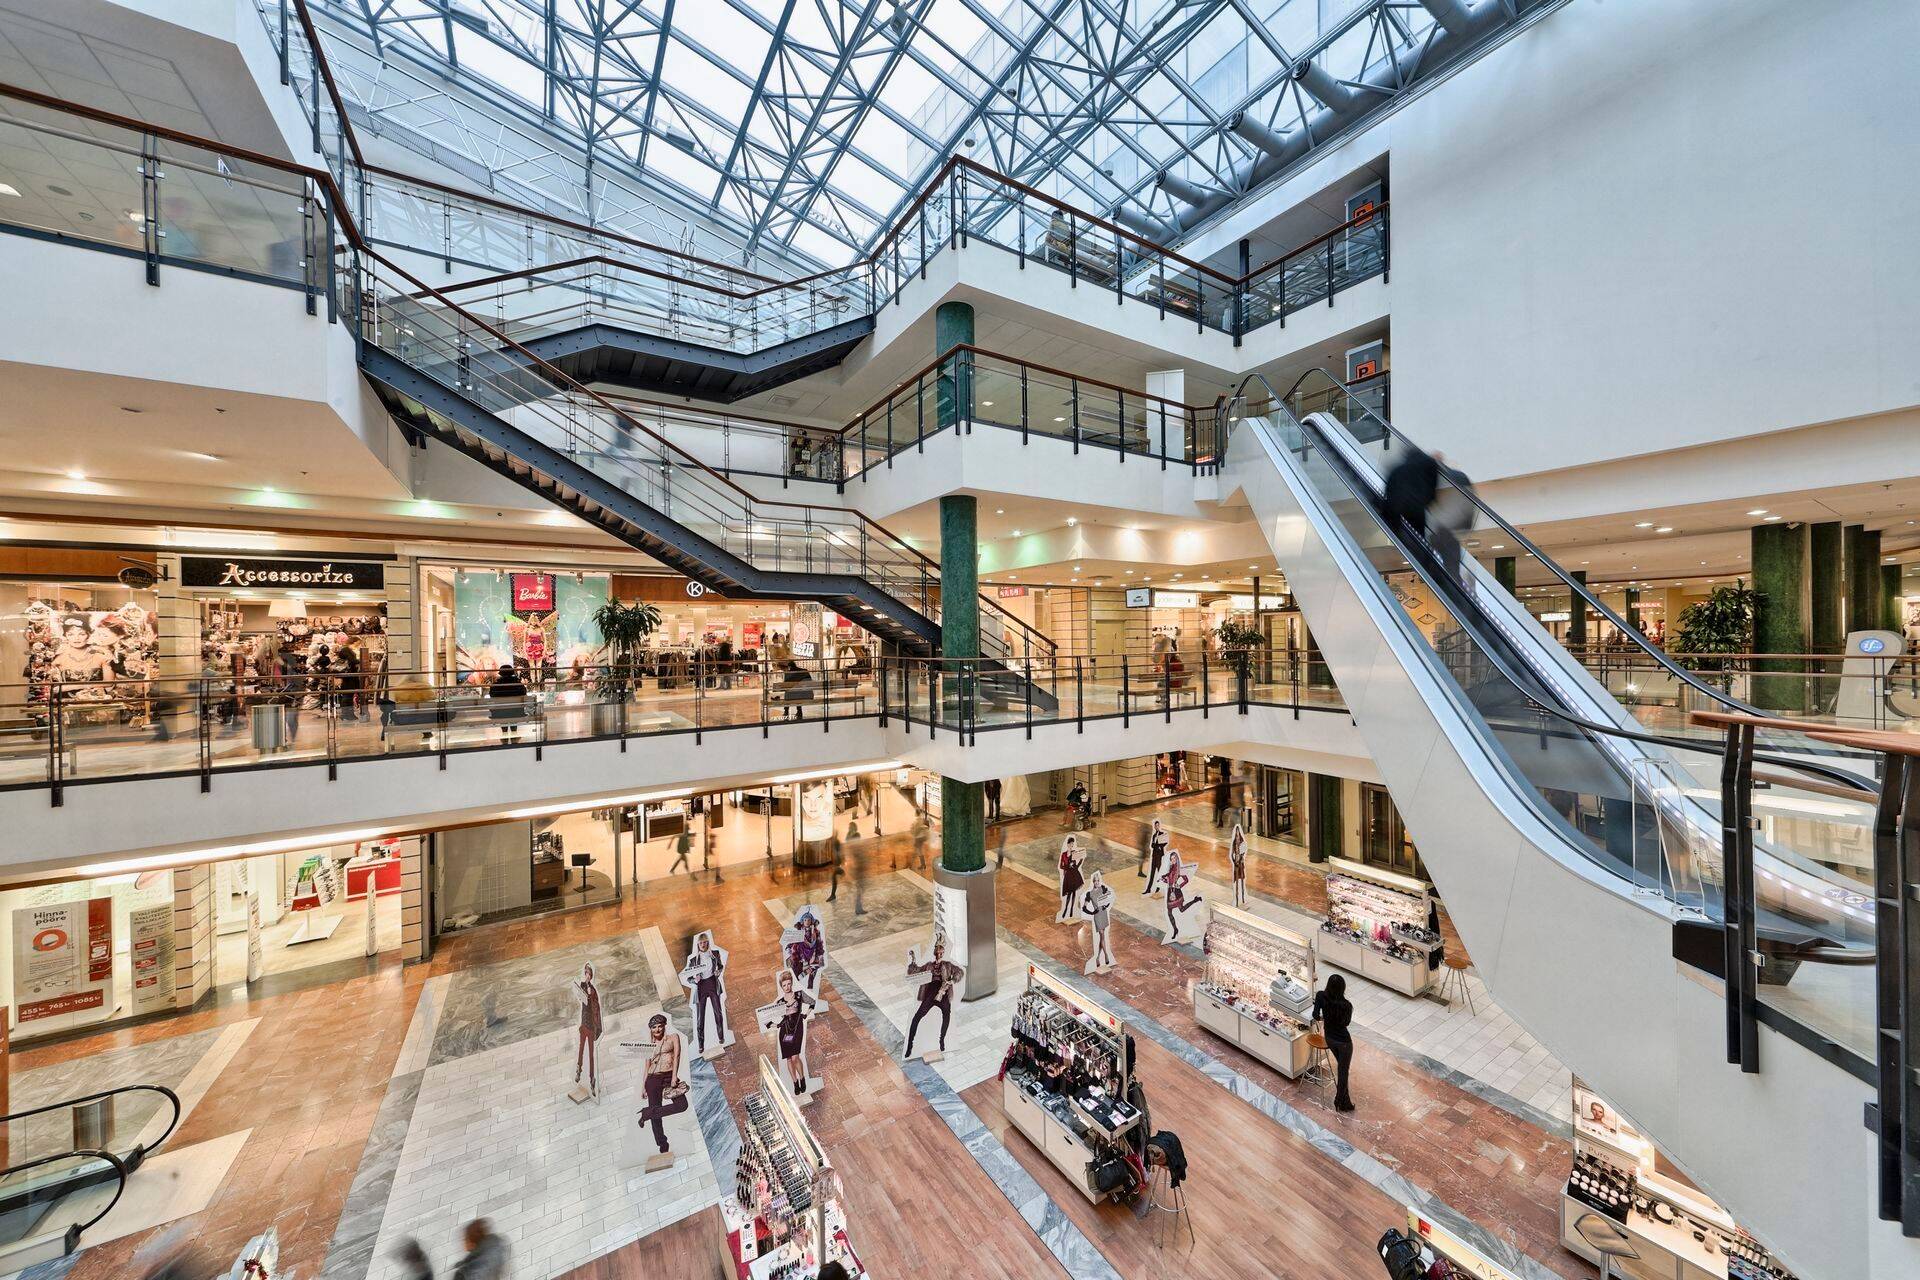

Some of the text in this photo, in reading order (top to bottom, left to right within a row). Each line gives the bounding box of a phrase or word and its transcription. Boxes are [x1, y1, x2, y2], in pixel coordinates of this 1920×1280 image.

[1358, 366, 1369, 379] P
[219, 562, 354, 587] Accessorize
[519, 587, 548, 601] Barbie
[34, 909, 68, 919] Hinna-
[21, 1007, 38, 1015] 455
[48, 1002, 64, 1010] 765
[74, 996, 94, 1005] 1085
